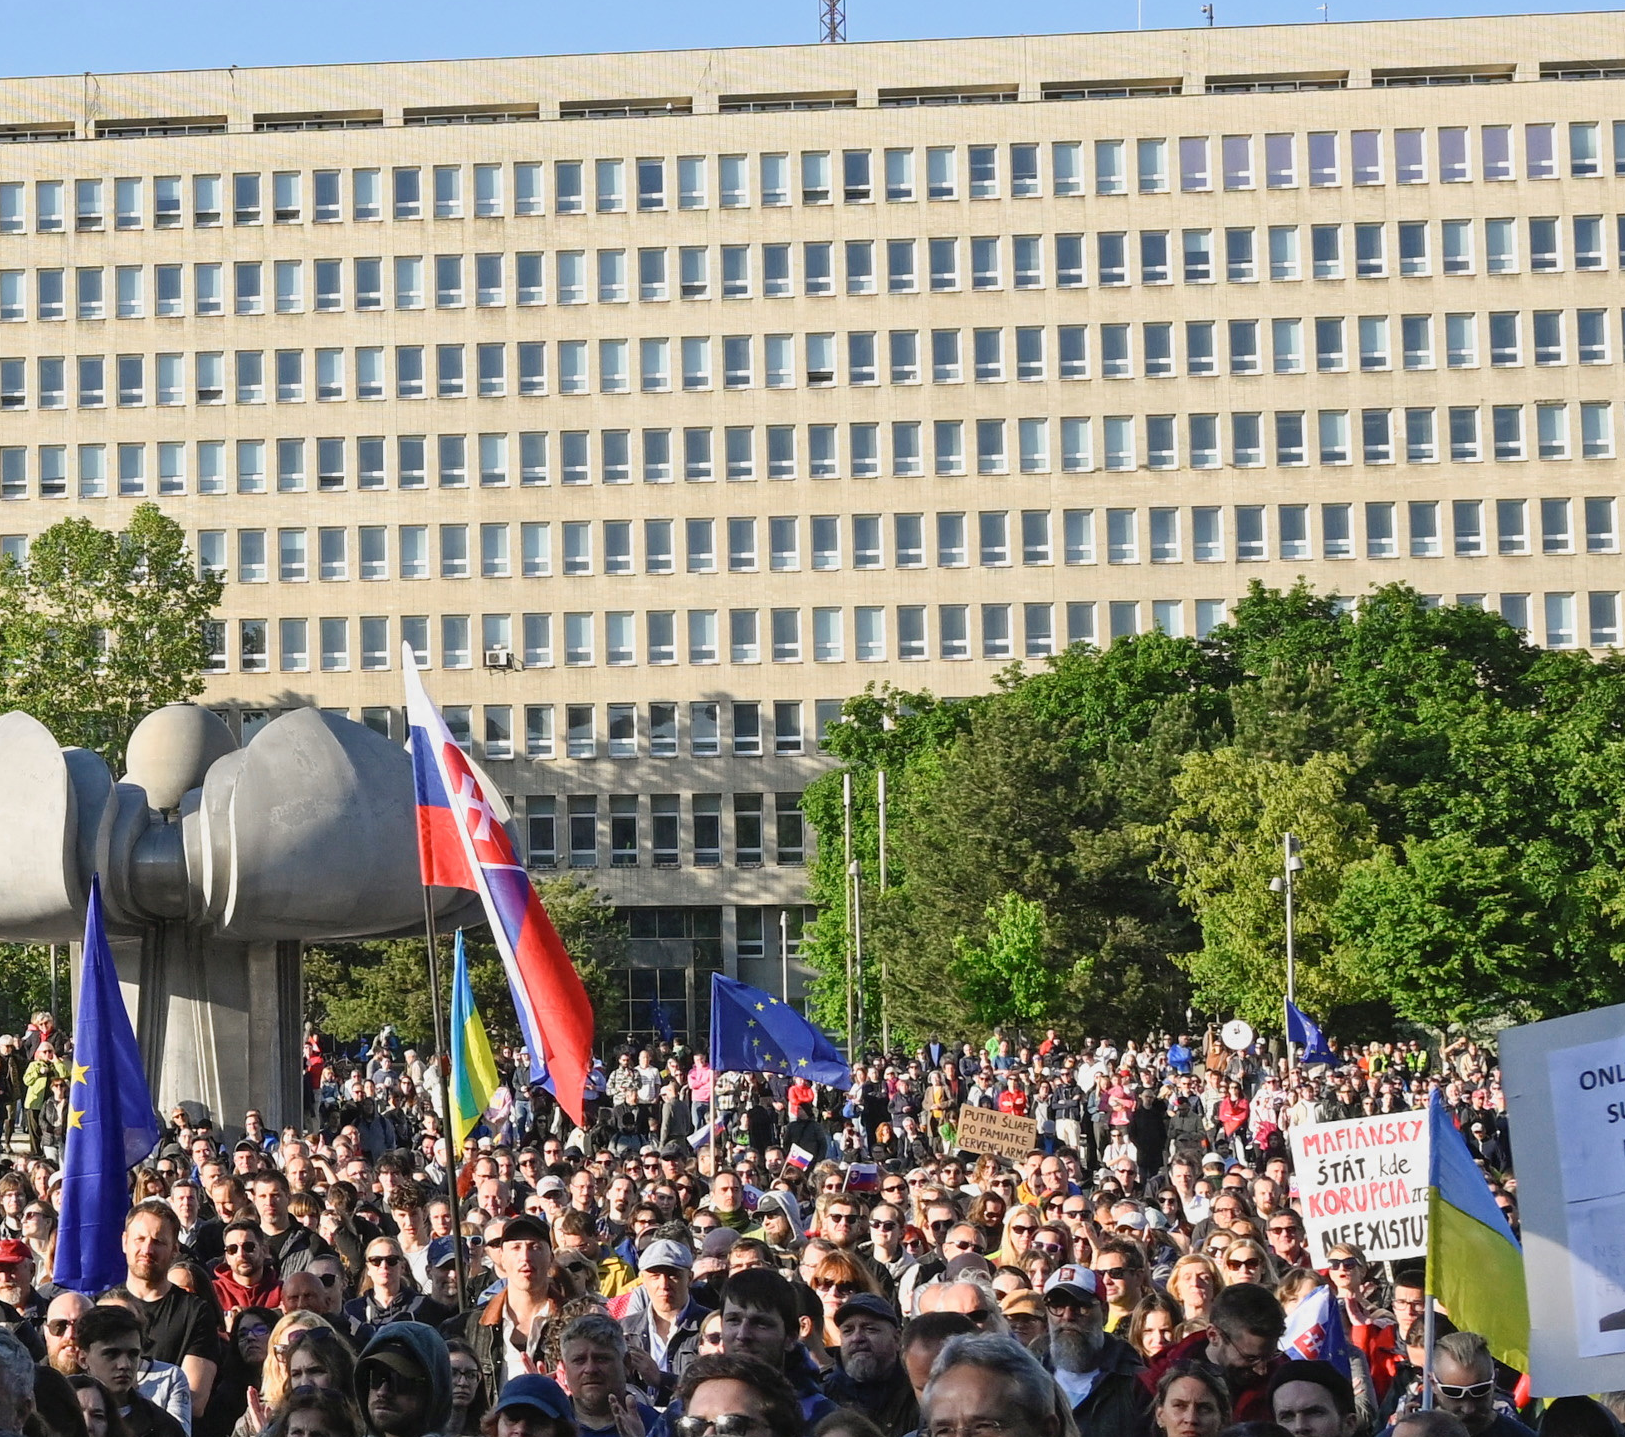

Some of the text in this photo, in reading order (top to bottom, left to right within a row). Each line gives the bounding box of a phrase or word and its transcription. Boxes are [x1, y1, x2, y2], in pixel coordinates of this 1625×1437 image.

[964, 1109, 1035, 1134] PUTIN ŠLIAPE
[958, 1135, 1004, 1155] ČERVENEJ
[962, 1123, 1028, 1146] PO PAMIATKE
[1302, 1120, 1423, 1157] MAFIÁNSKY
[1379, 1153, 1411, 1177] kde
[1308, 1178, 1411, 1218] KORUPCIA
[1321, 1215, 1429, 1258] NEEXISTU
